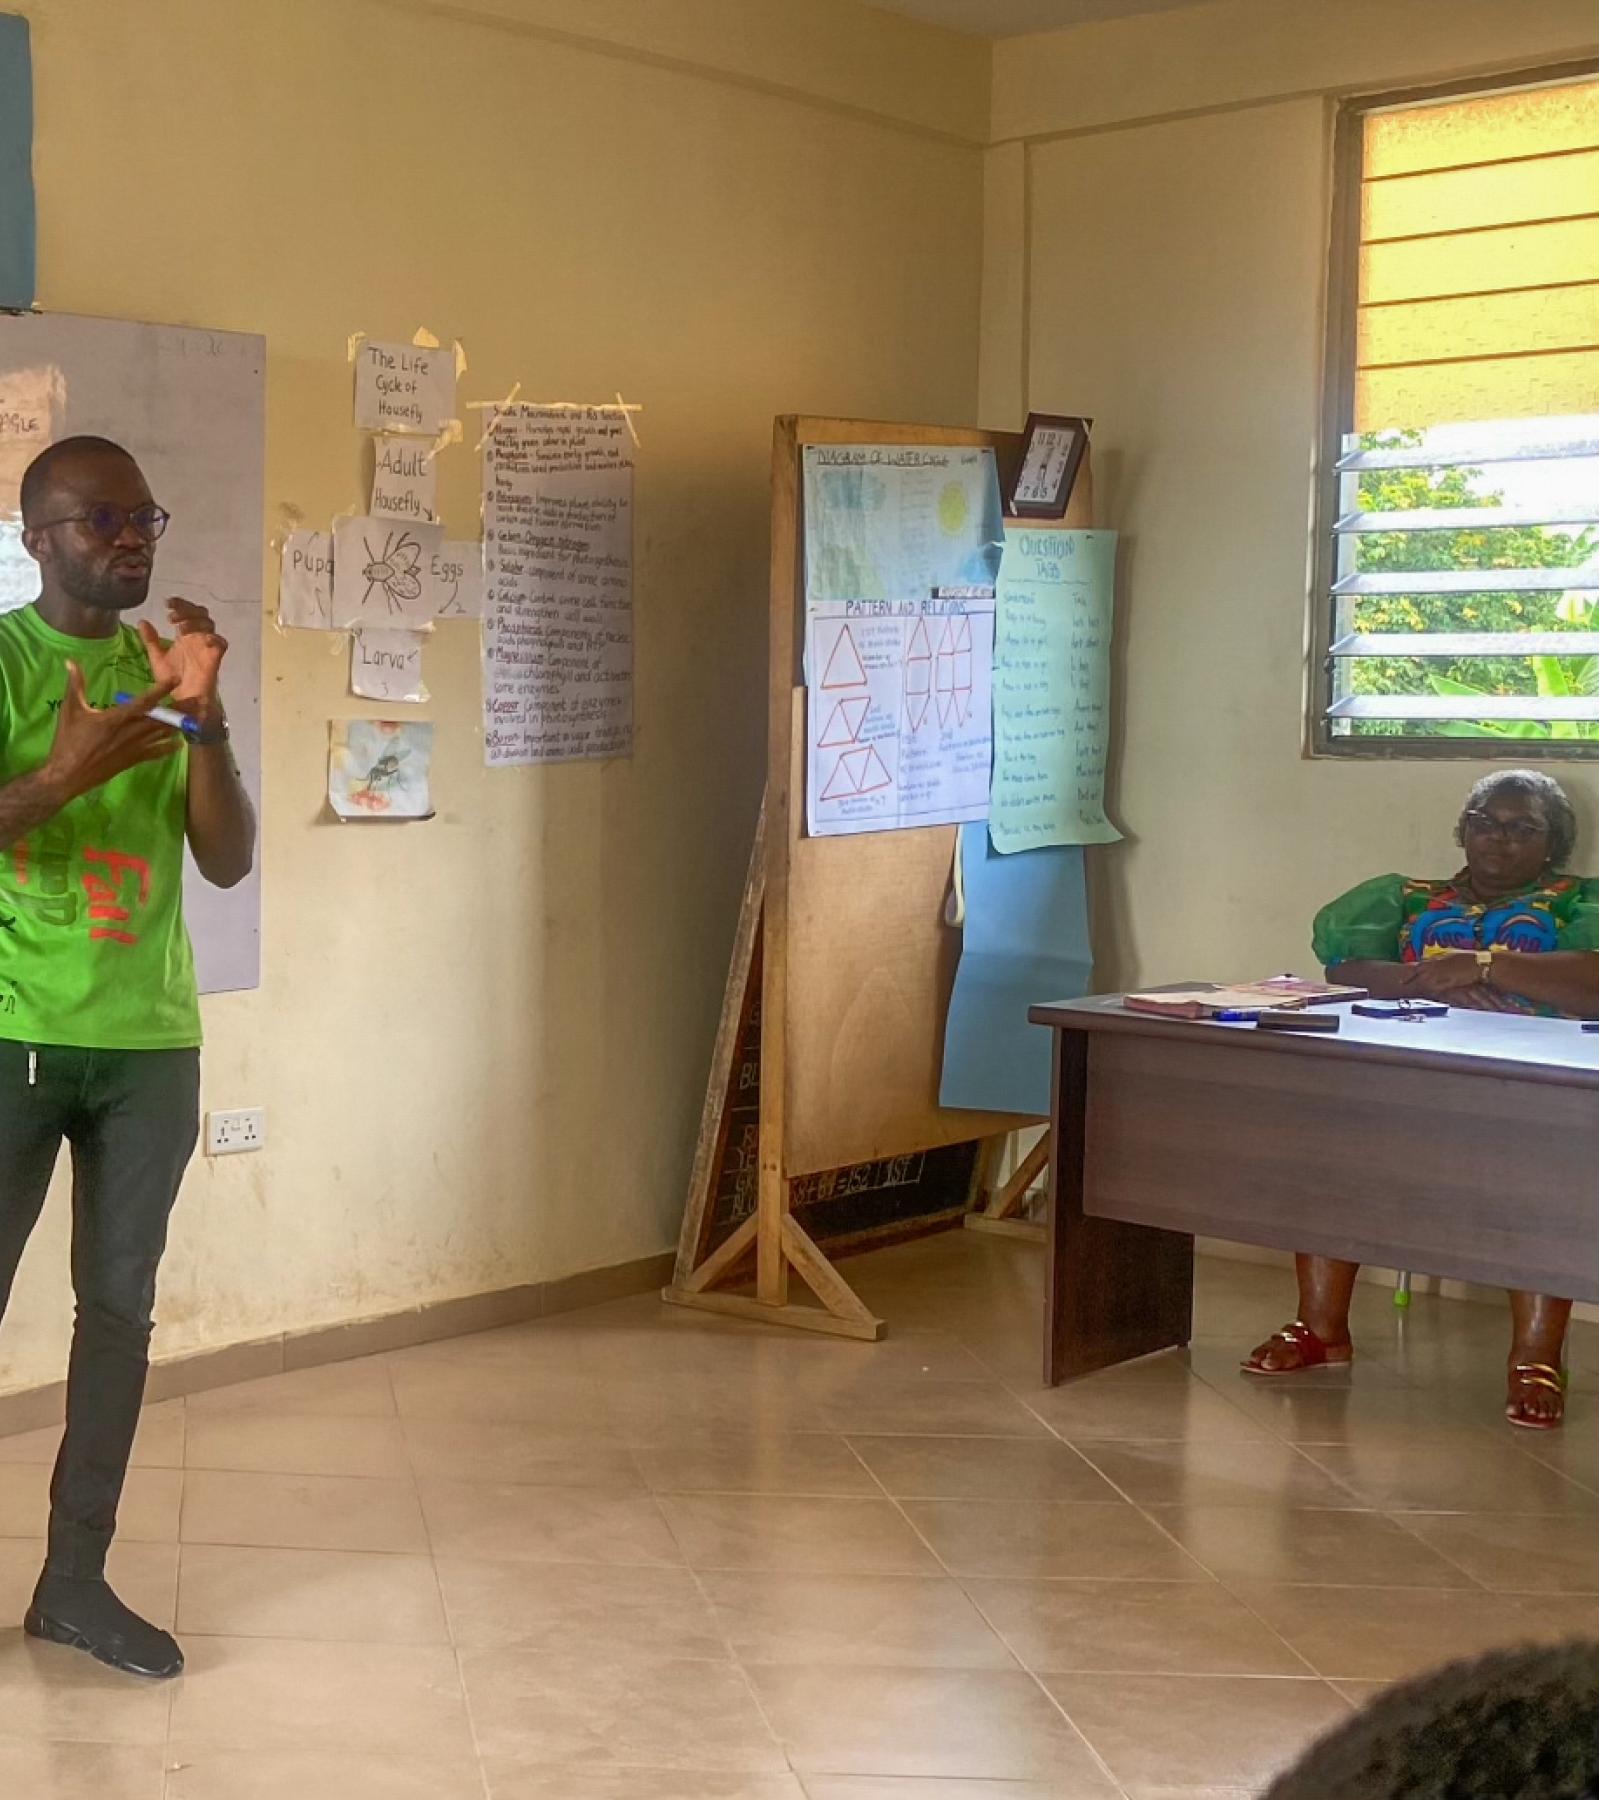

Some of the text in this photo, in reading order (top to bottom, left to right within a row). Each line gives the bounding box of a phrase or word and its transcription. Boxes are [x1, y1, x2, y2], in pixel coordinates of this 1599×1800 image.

[368, 346, 429, 375] The Life
[375, 374, 417, 396] Cycle of
[378, 400, 423, 424] Housefly
[375, 488, 421, 517] Housefly
[431, 555, 464, 583] Eggs
[846, 600, 893, 617] PATTERN
[363, 646, 405, 671] Larva
